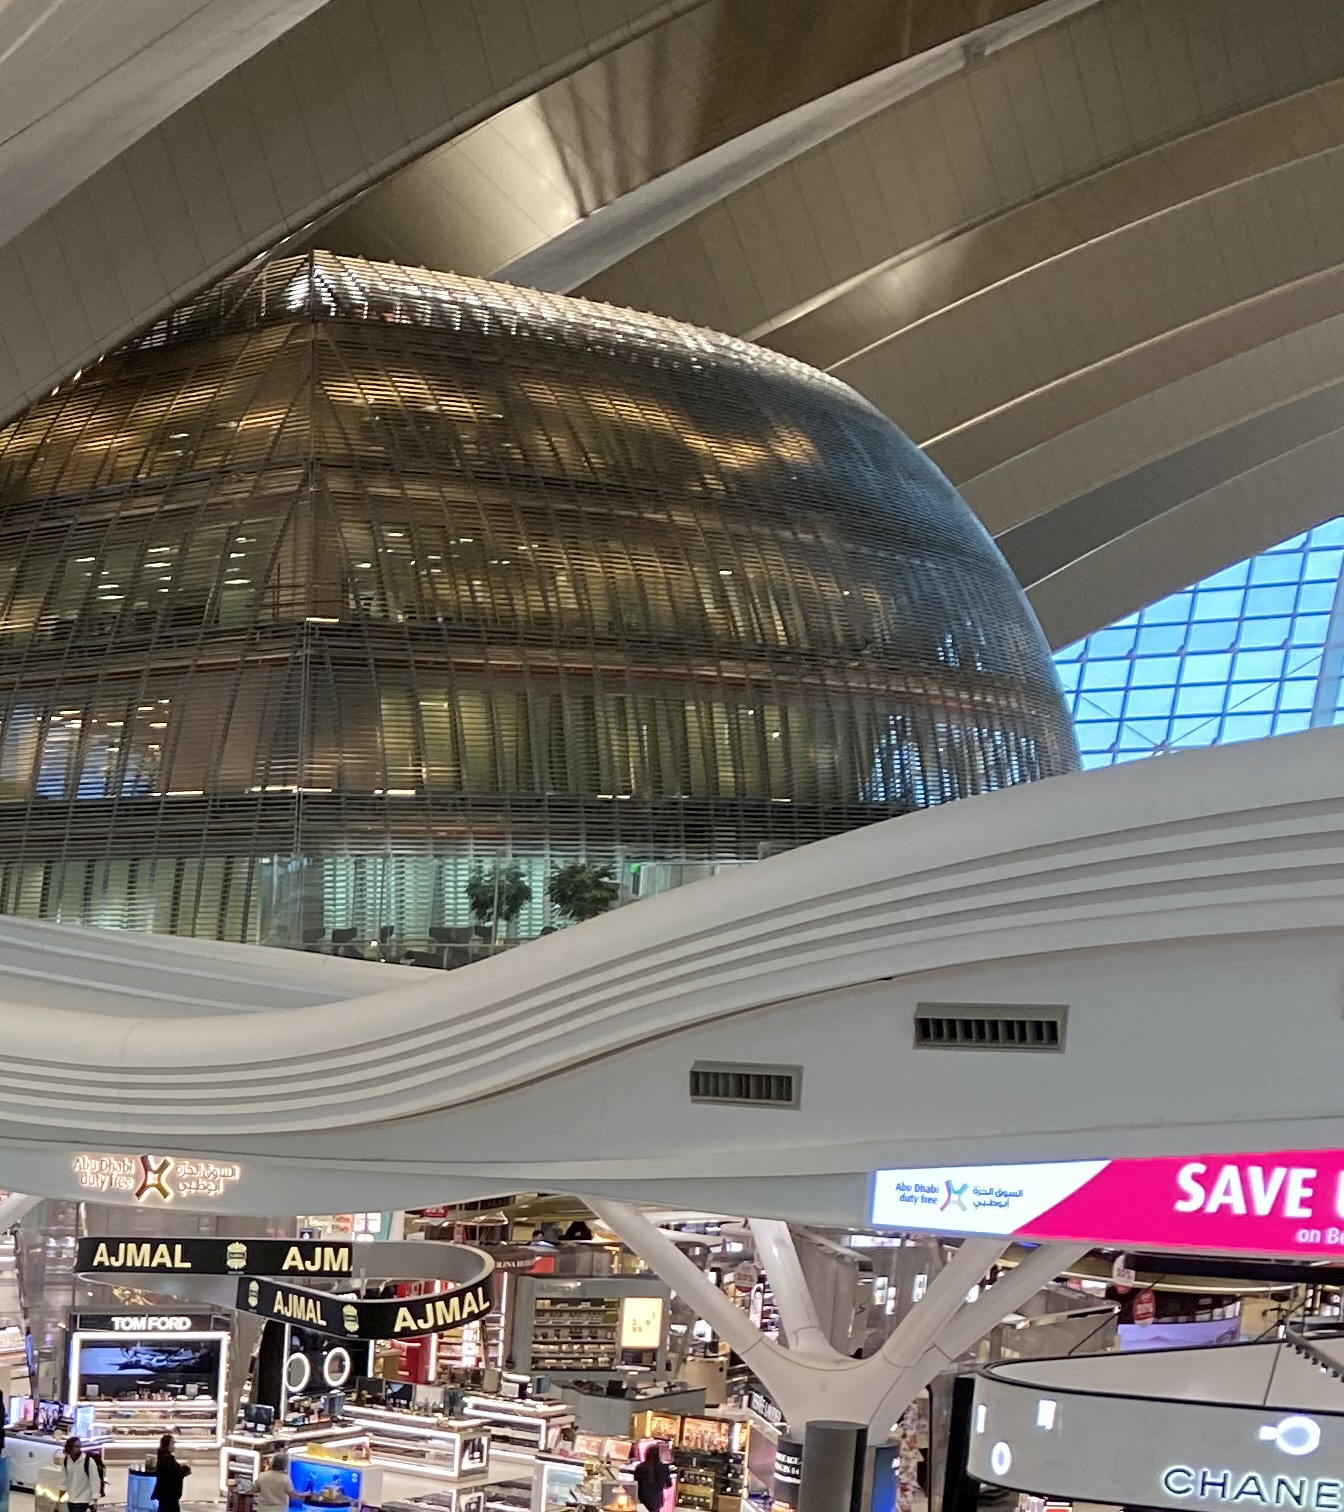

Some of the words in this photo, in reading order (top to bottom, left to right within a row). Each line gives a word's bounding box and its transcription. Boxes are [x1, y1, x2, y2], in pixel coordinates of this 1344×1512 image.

[73, 1155, 99, 1172] Abu
[100, 1157, 136, 1174] Dhabi
[80, 1171, 109, 1191] duty
[110, 1170, 136, 1190] free
[895, 1181, 913, 1193] Abu
[914, 1183, 939, 1194] Dhabi
[1174, 1162, 1317, 1218] SAVE
[899, 1193, 919, 1206] duty
[920, 1194, 938, 1205] free
[1296, 1229, 1321, 1244] on
[92, 1242, 192, 1269] AJMAL
[281, 1246, 353, 1272] AJM
[273, 1290, 327, 1327] AJMAL
[394, 1286, 490, 1333] AJMAL
[111, 1317, 147, 1331] TOM
[147, 1316, 192, 1331] FORD
